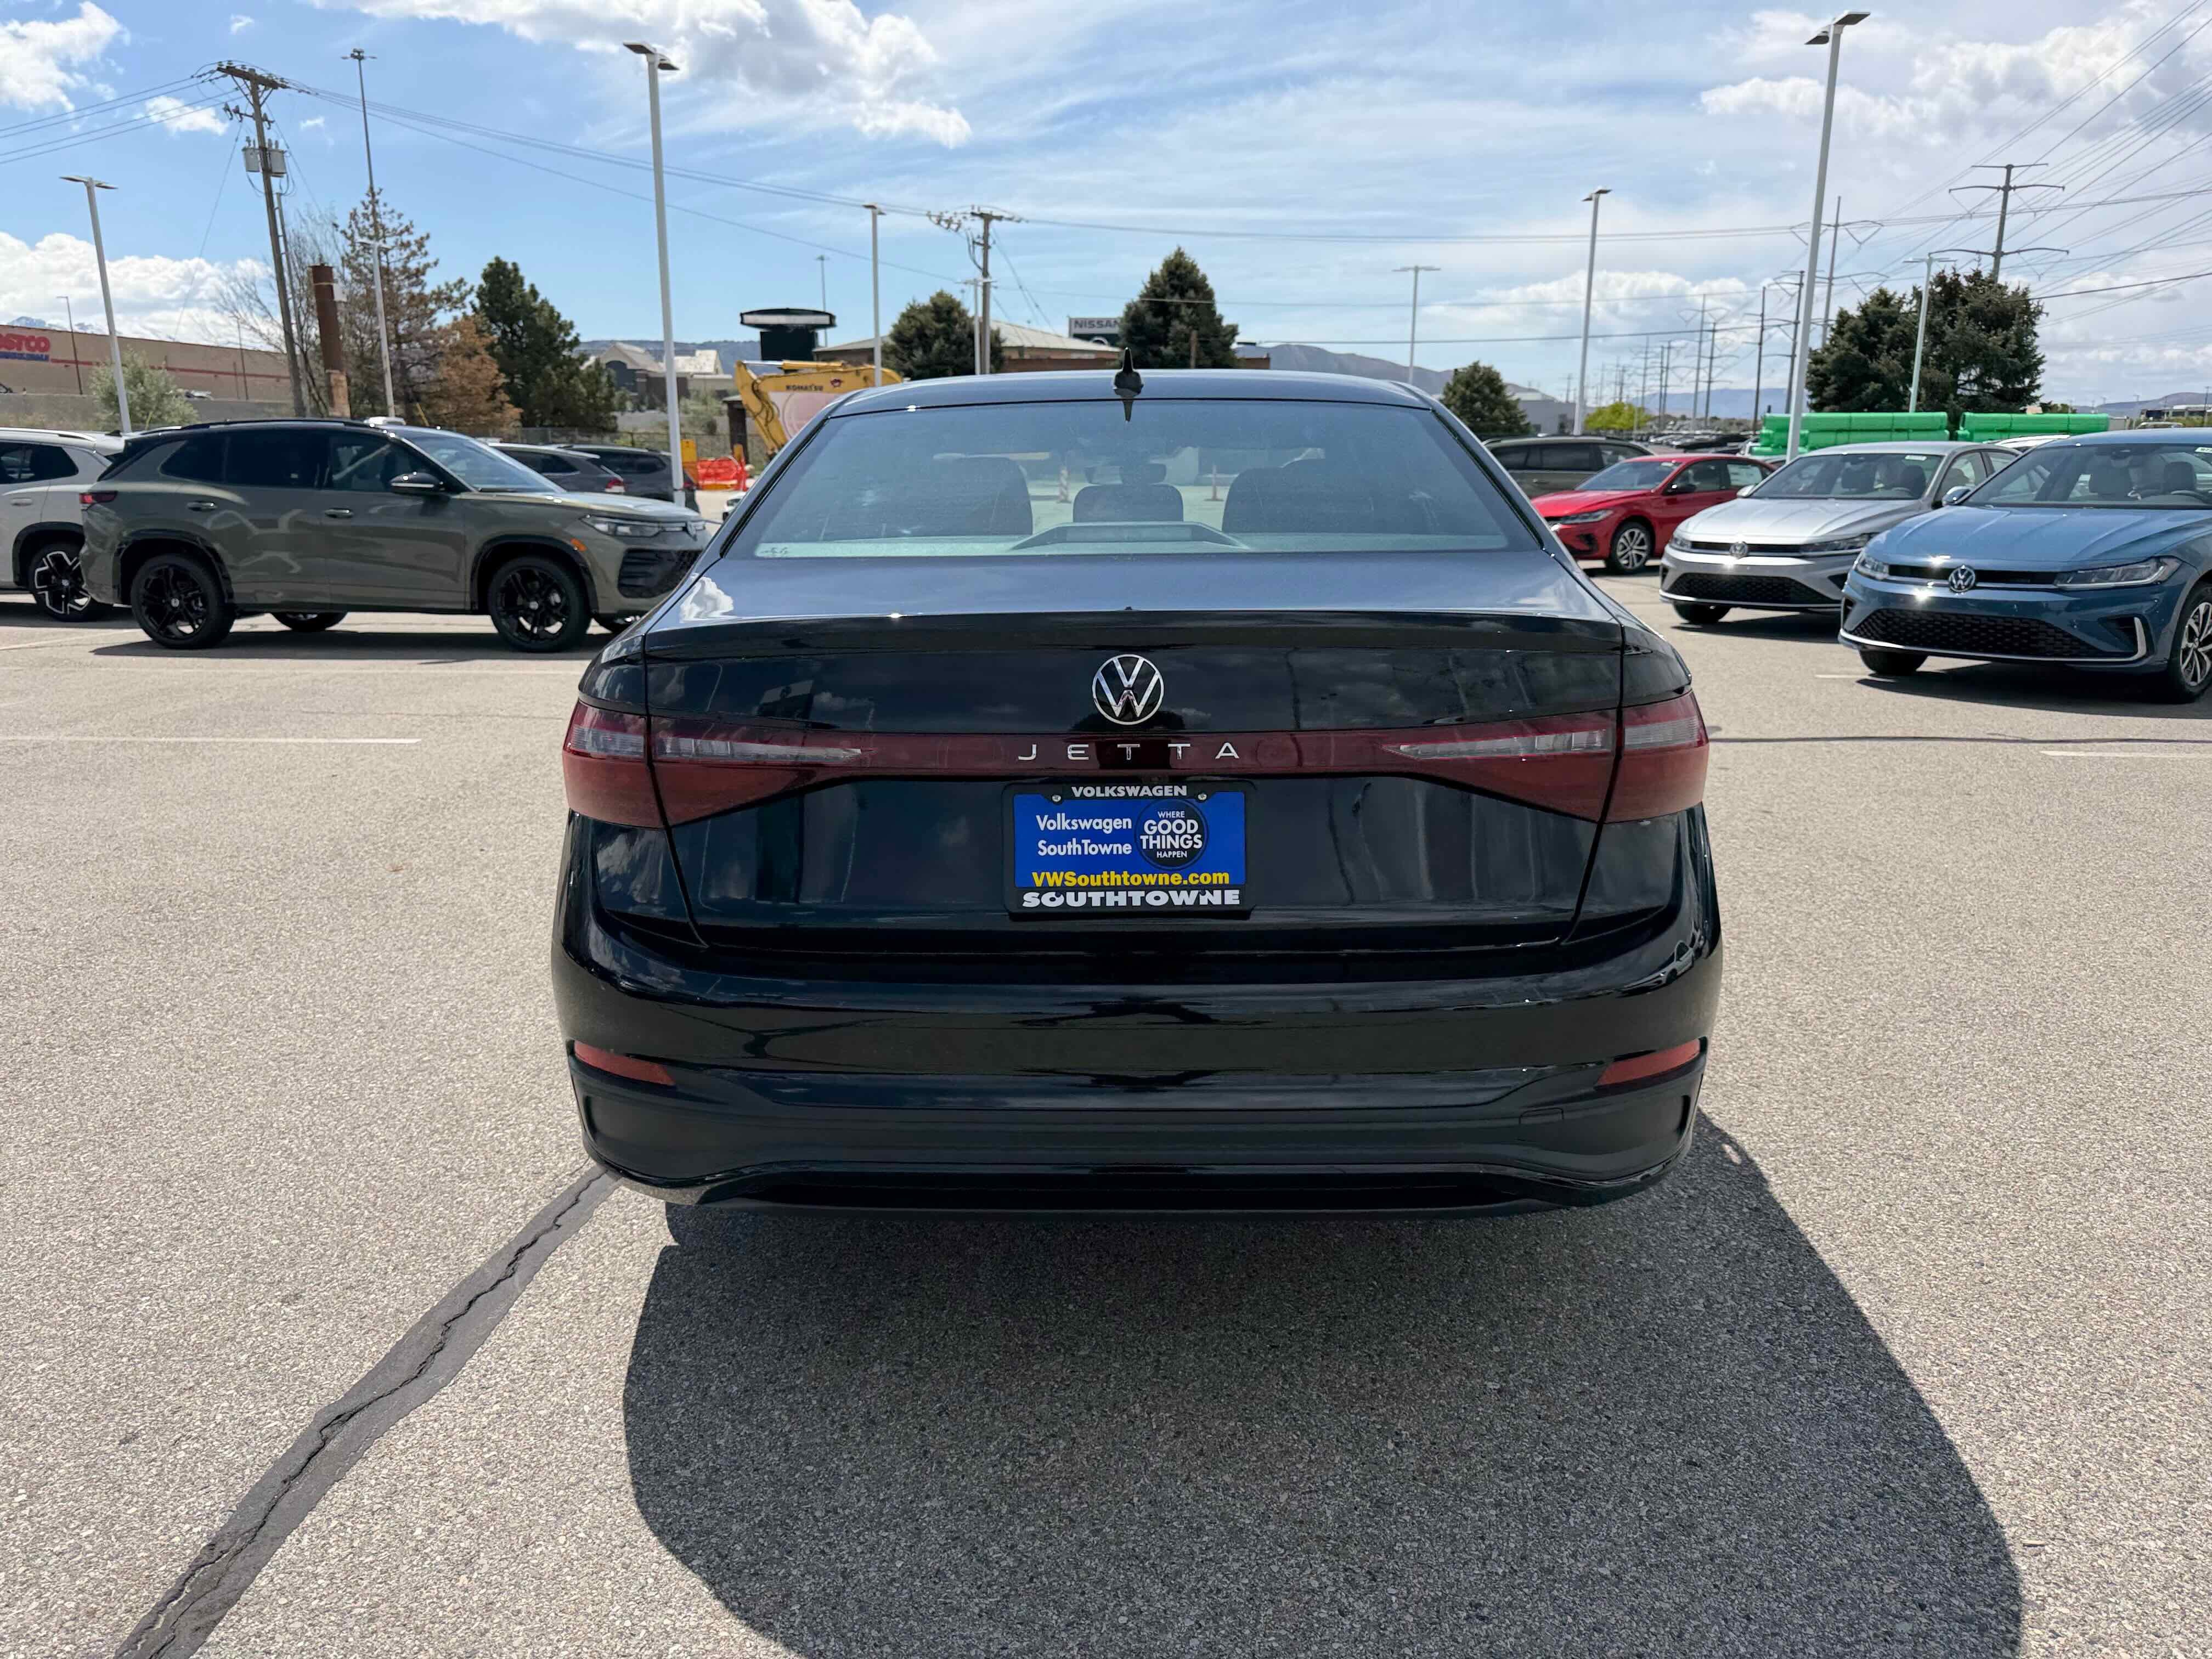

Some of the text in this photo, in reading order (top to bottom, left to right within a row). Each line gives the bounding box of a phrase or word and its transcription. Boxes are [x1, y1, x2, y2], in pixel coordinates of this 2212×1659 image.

[1018, 742, 1240, 761] JETTA
[1071, 785, 1187, 798] VOLKSWAGEN
[1036, 812, 1132, 834] Volkswagen
[1144, 820, 1199, 835] GOOD
[1140, 834, 1203, 850] THINGS
[1156, 850, 1188, 859] HAPPEN
[1032, 871, 1229, 887] VWSouthtowne.com
[1022, 889, 1240, 908] SOUTHTOWNE
